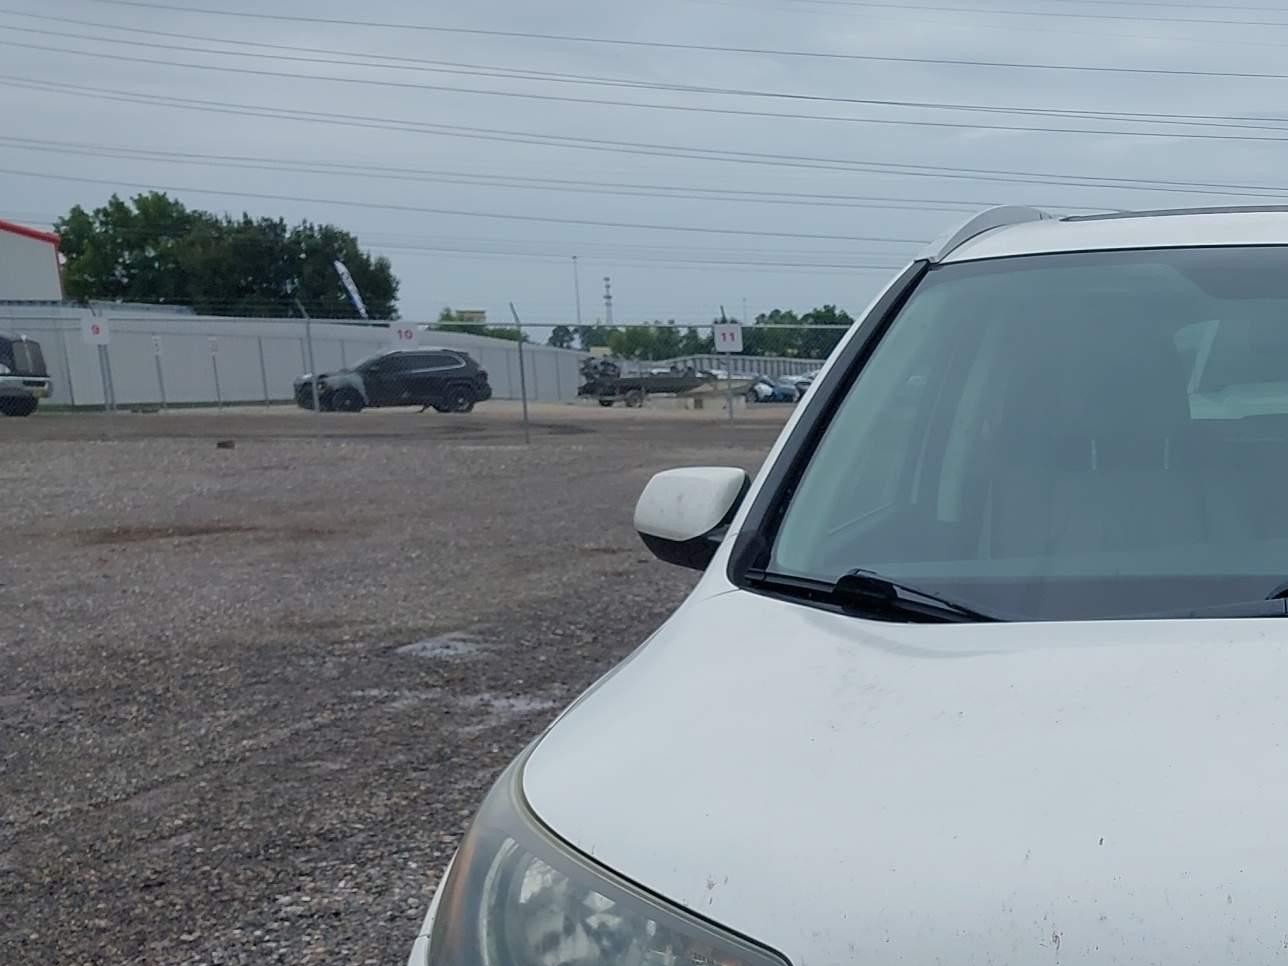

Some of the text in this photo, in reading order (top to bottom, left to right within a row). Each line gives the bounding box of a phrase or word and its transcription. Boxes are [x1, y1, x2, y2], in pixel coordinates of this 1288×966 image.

[90, 324, 100, 335] 9
[397, 329, 414, 340] 10
[721, 332, 736, 342] 11
